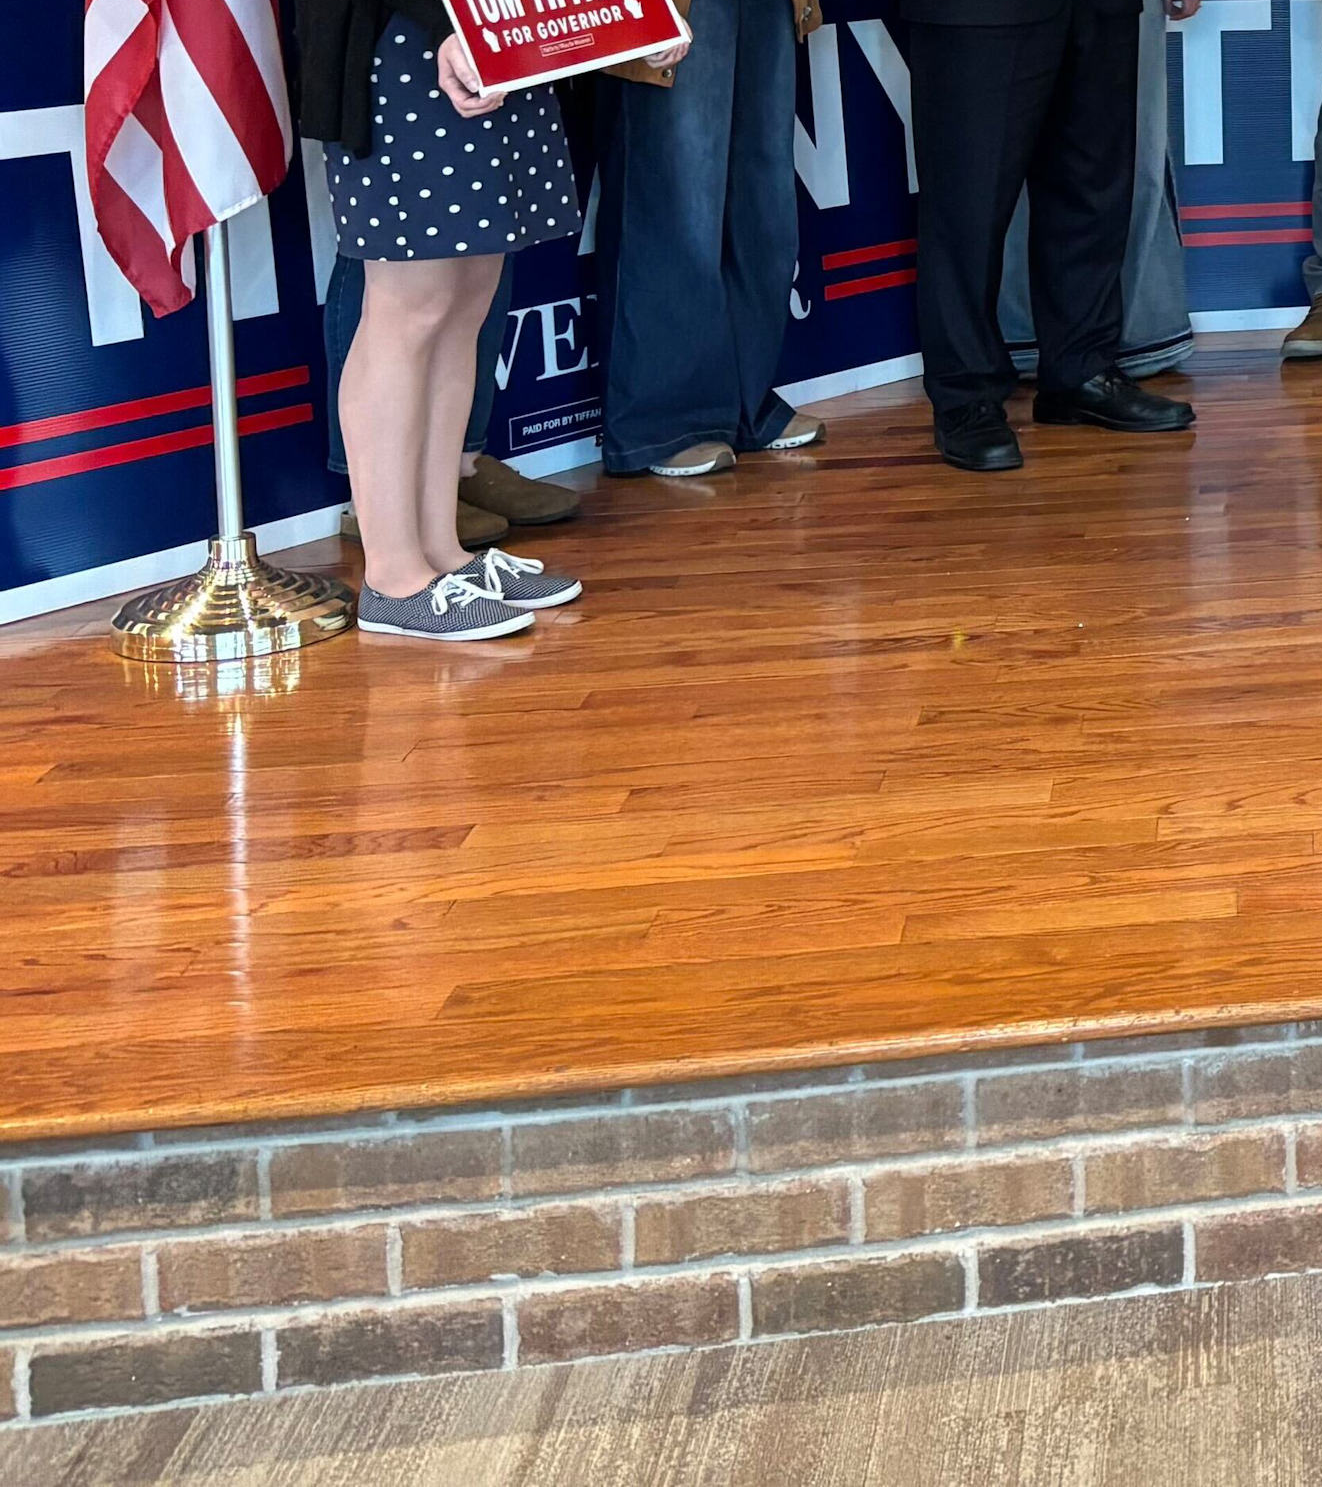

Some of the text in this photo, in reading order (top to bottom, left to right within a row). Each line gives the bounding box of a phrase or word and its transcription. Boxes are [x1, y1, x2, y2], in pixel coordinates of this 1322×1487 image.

[502, 24, 534, 47] FOR
[536, 6, 624, 39] GOVERNOR
[522, 423, 542, 436] PAID
[561, 414, 573, 426] BY
[574, 408, 602, 422] TIFFAN
